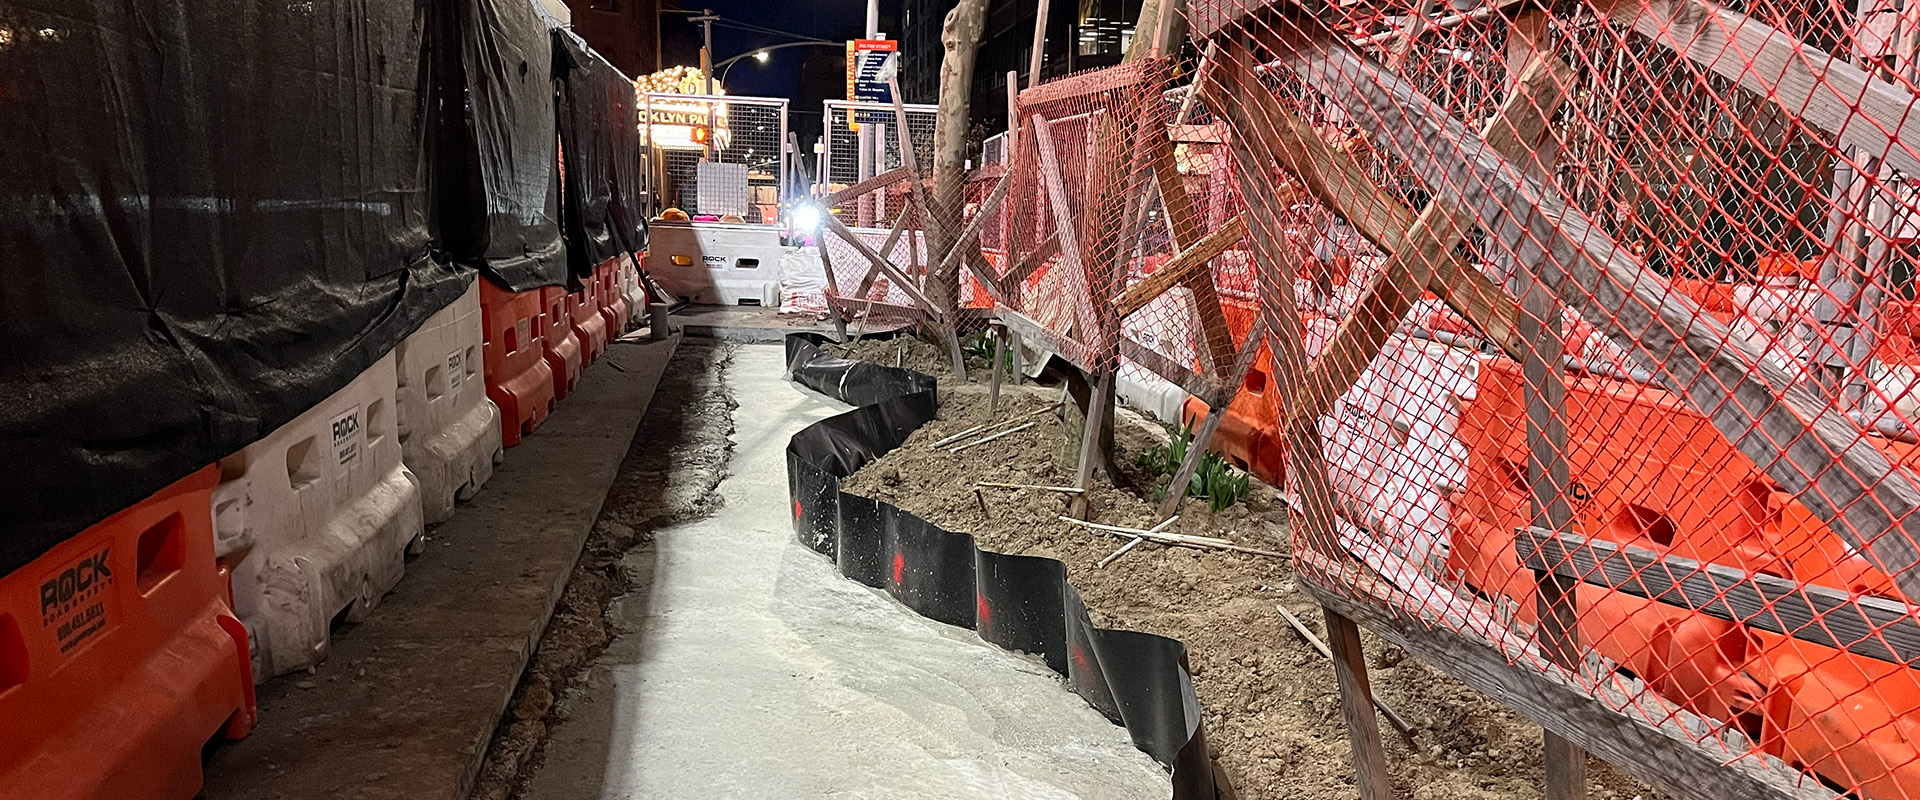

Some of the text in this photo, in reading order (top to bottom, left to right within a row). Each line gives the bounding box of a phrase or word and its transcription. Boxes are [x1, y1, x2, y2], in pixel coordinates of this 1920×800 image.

[847, 50, 855, 102] DOWNTOW
[638, 110, 686, 123] OKLYN
[702, 255, 726, 263] ROCK
[332, 411, 359, 441] ROCK
[41, 548, 112, 616] ROCK
